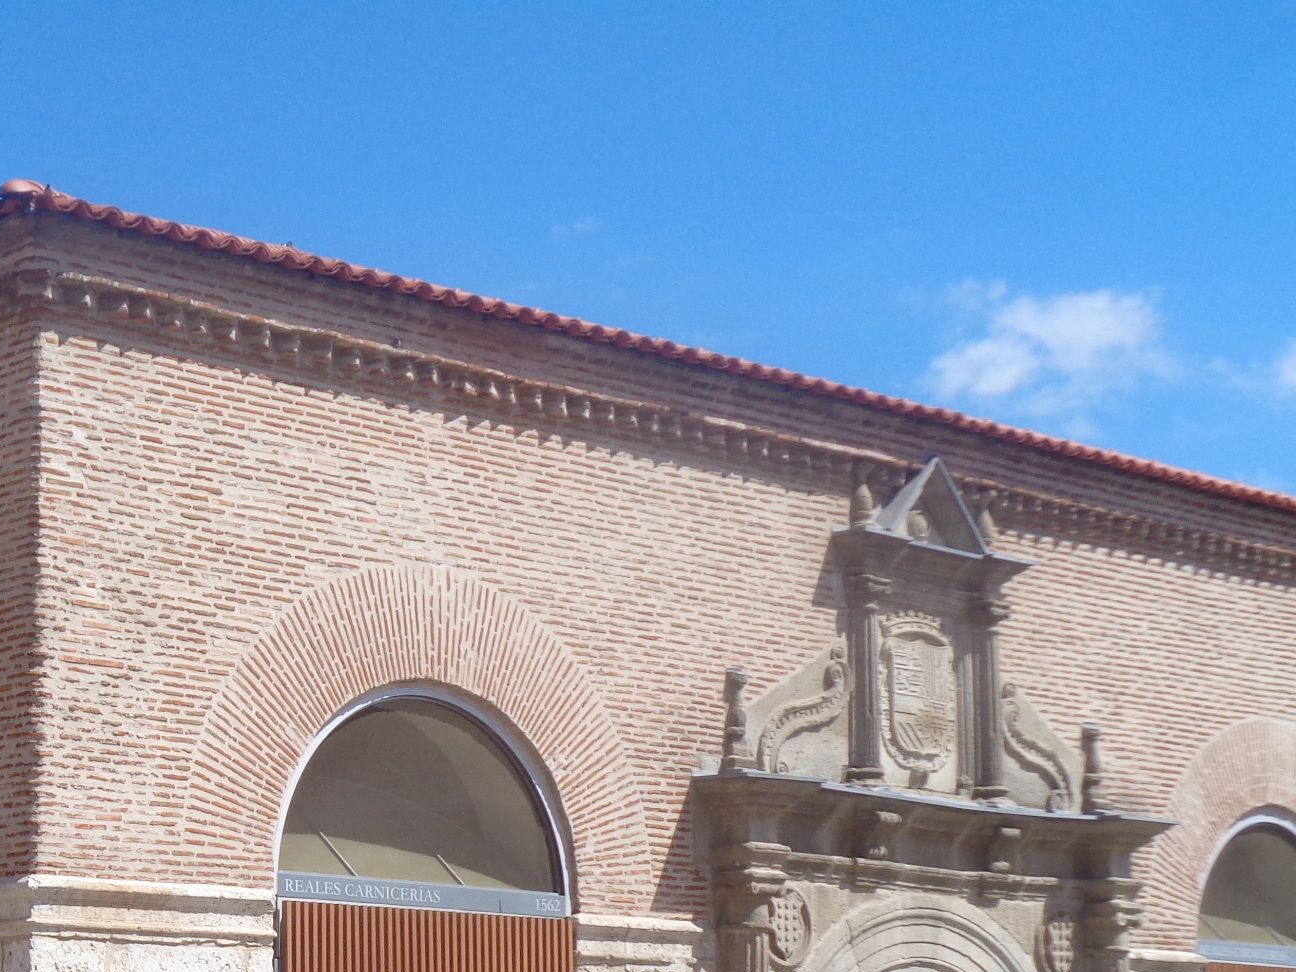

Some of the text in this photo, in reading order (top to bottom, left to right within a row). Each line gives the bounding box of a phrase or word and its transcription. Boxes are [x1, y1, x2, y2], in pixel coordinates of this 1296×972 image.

[284, 878, 561, 912] REALES CARNICERÍAS 1562
